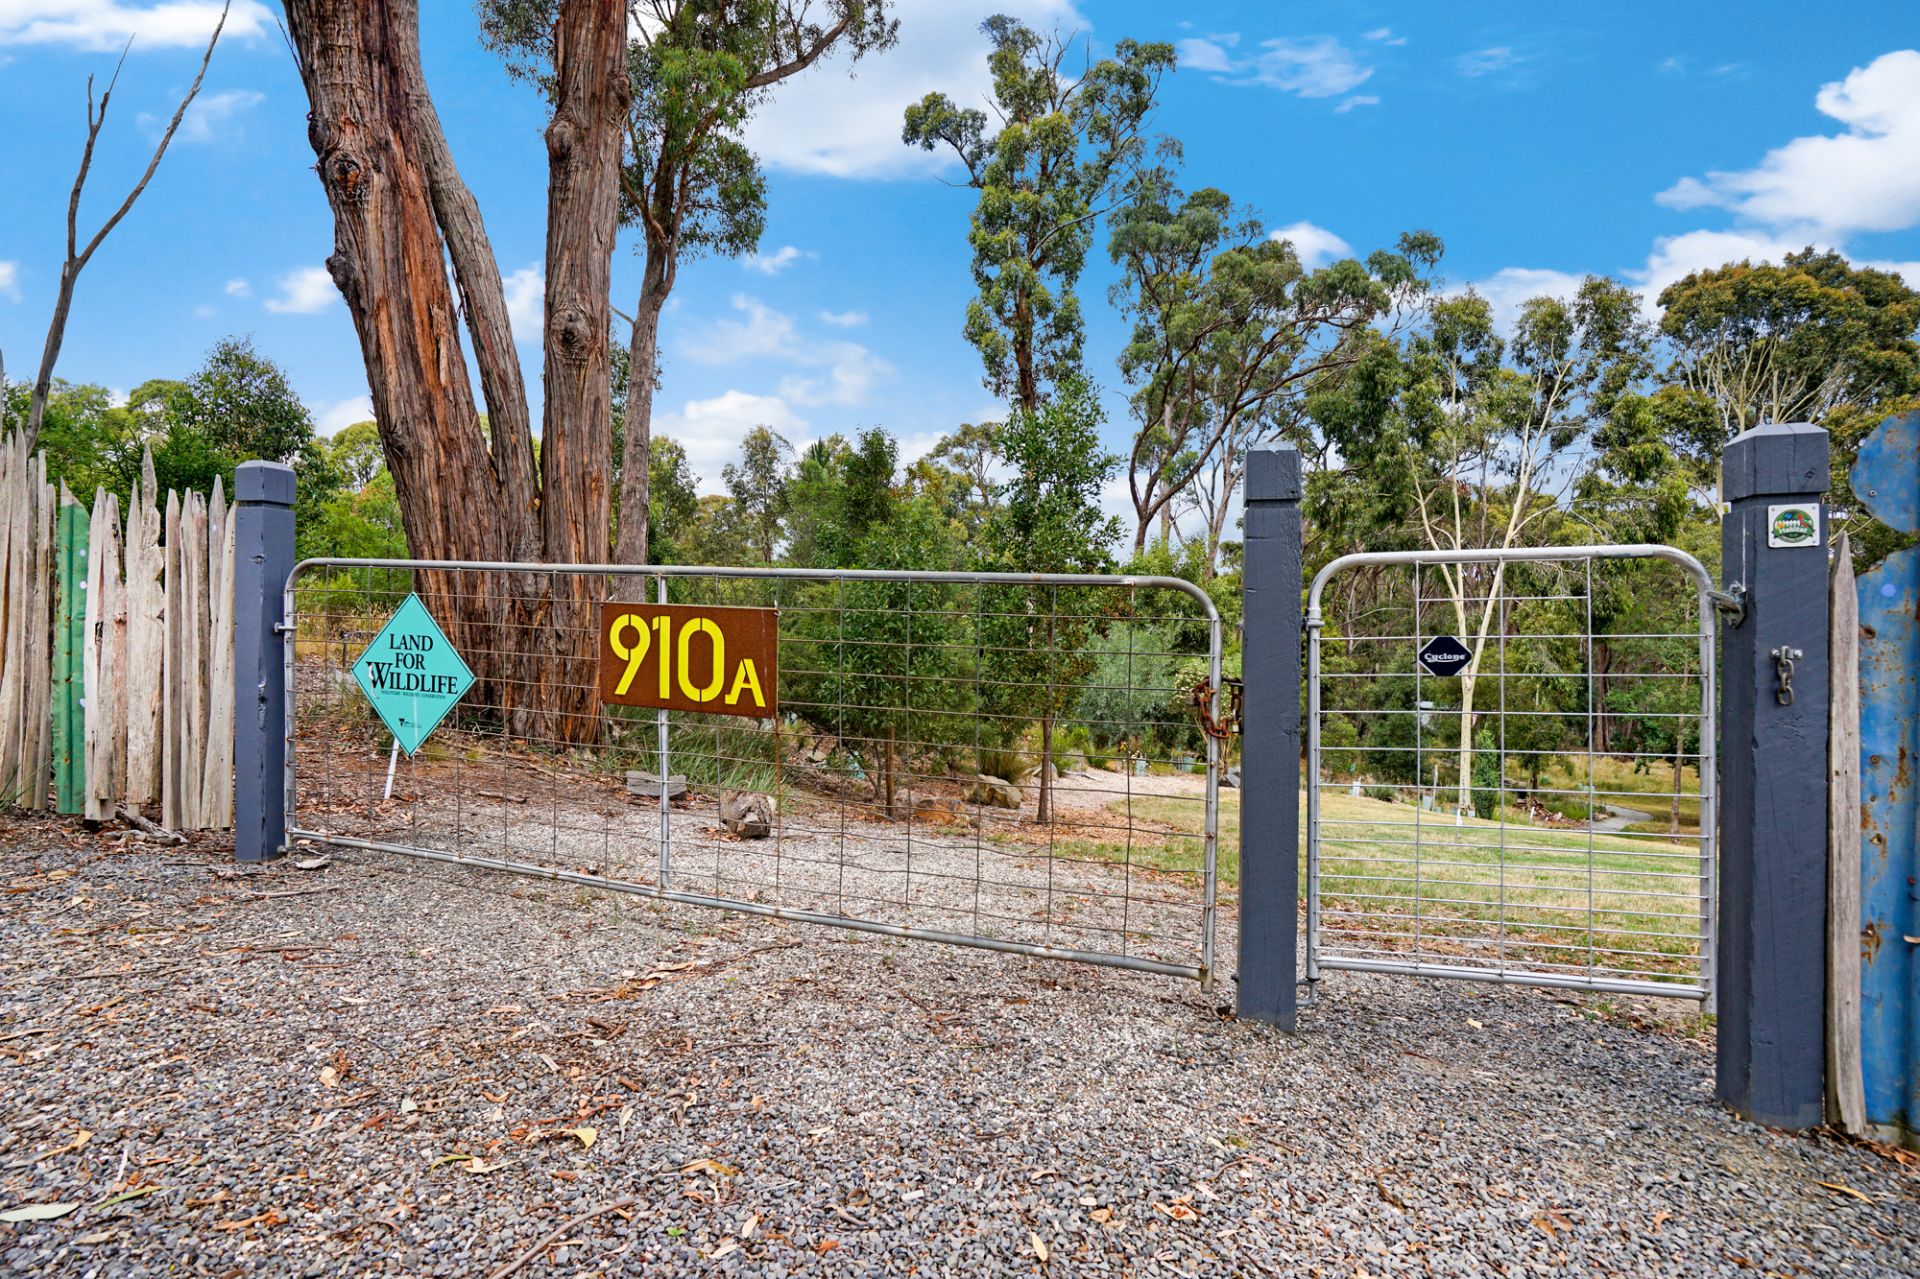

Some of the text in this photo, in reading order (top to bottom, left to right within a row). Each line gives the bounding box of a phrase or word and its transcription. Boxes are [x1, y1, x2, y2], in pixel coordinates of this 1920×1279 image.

[390, 633, 433, 652] LAND
[395, 652, 426, 670] FOR
[365, 661, 459, 695] WILDLIFE
